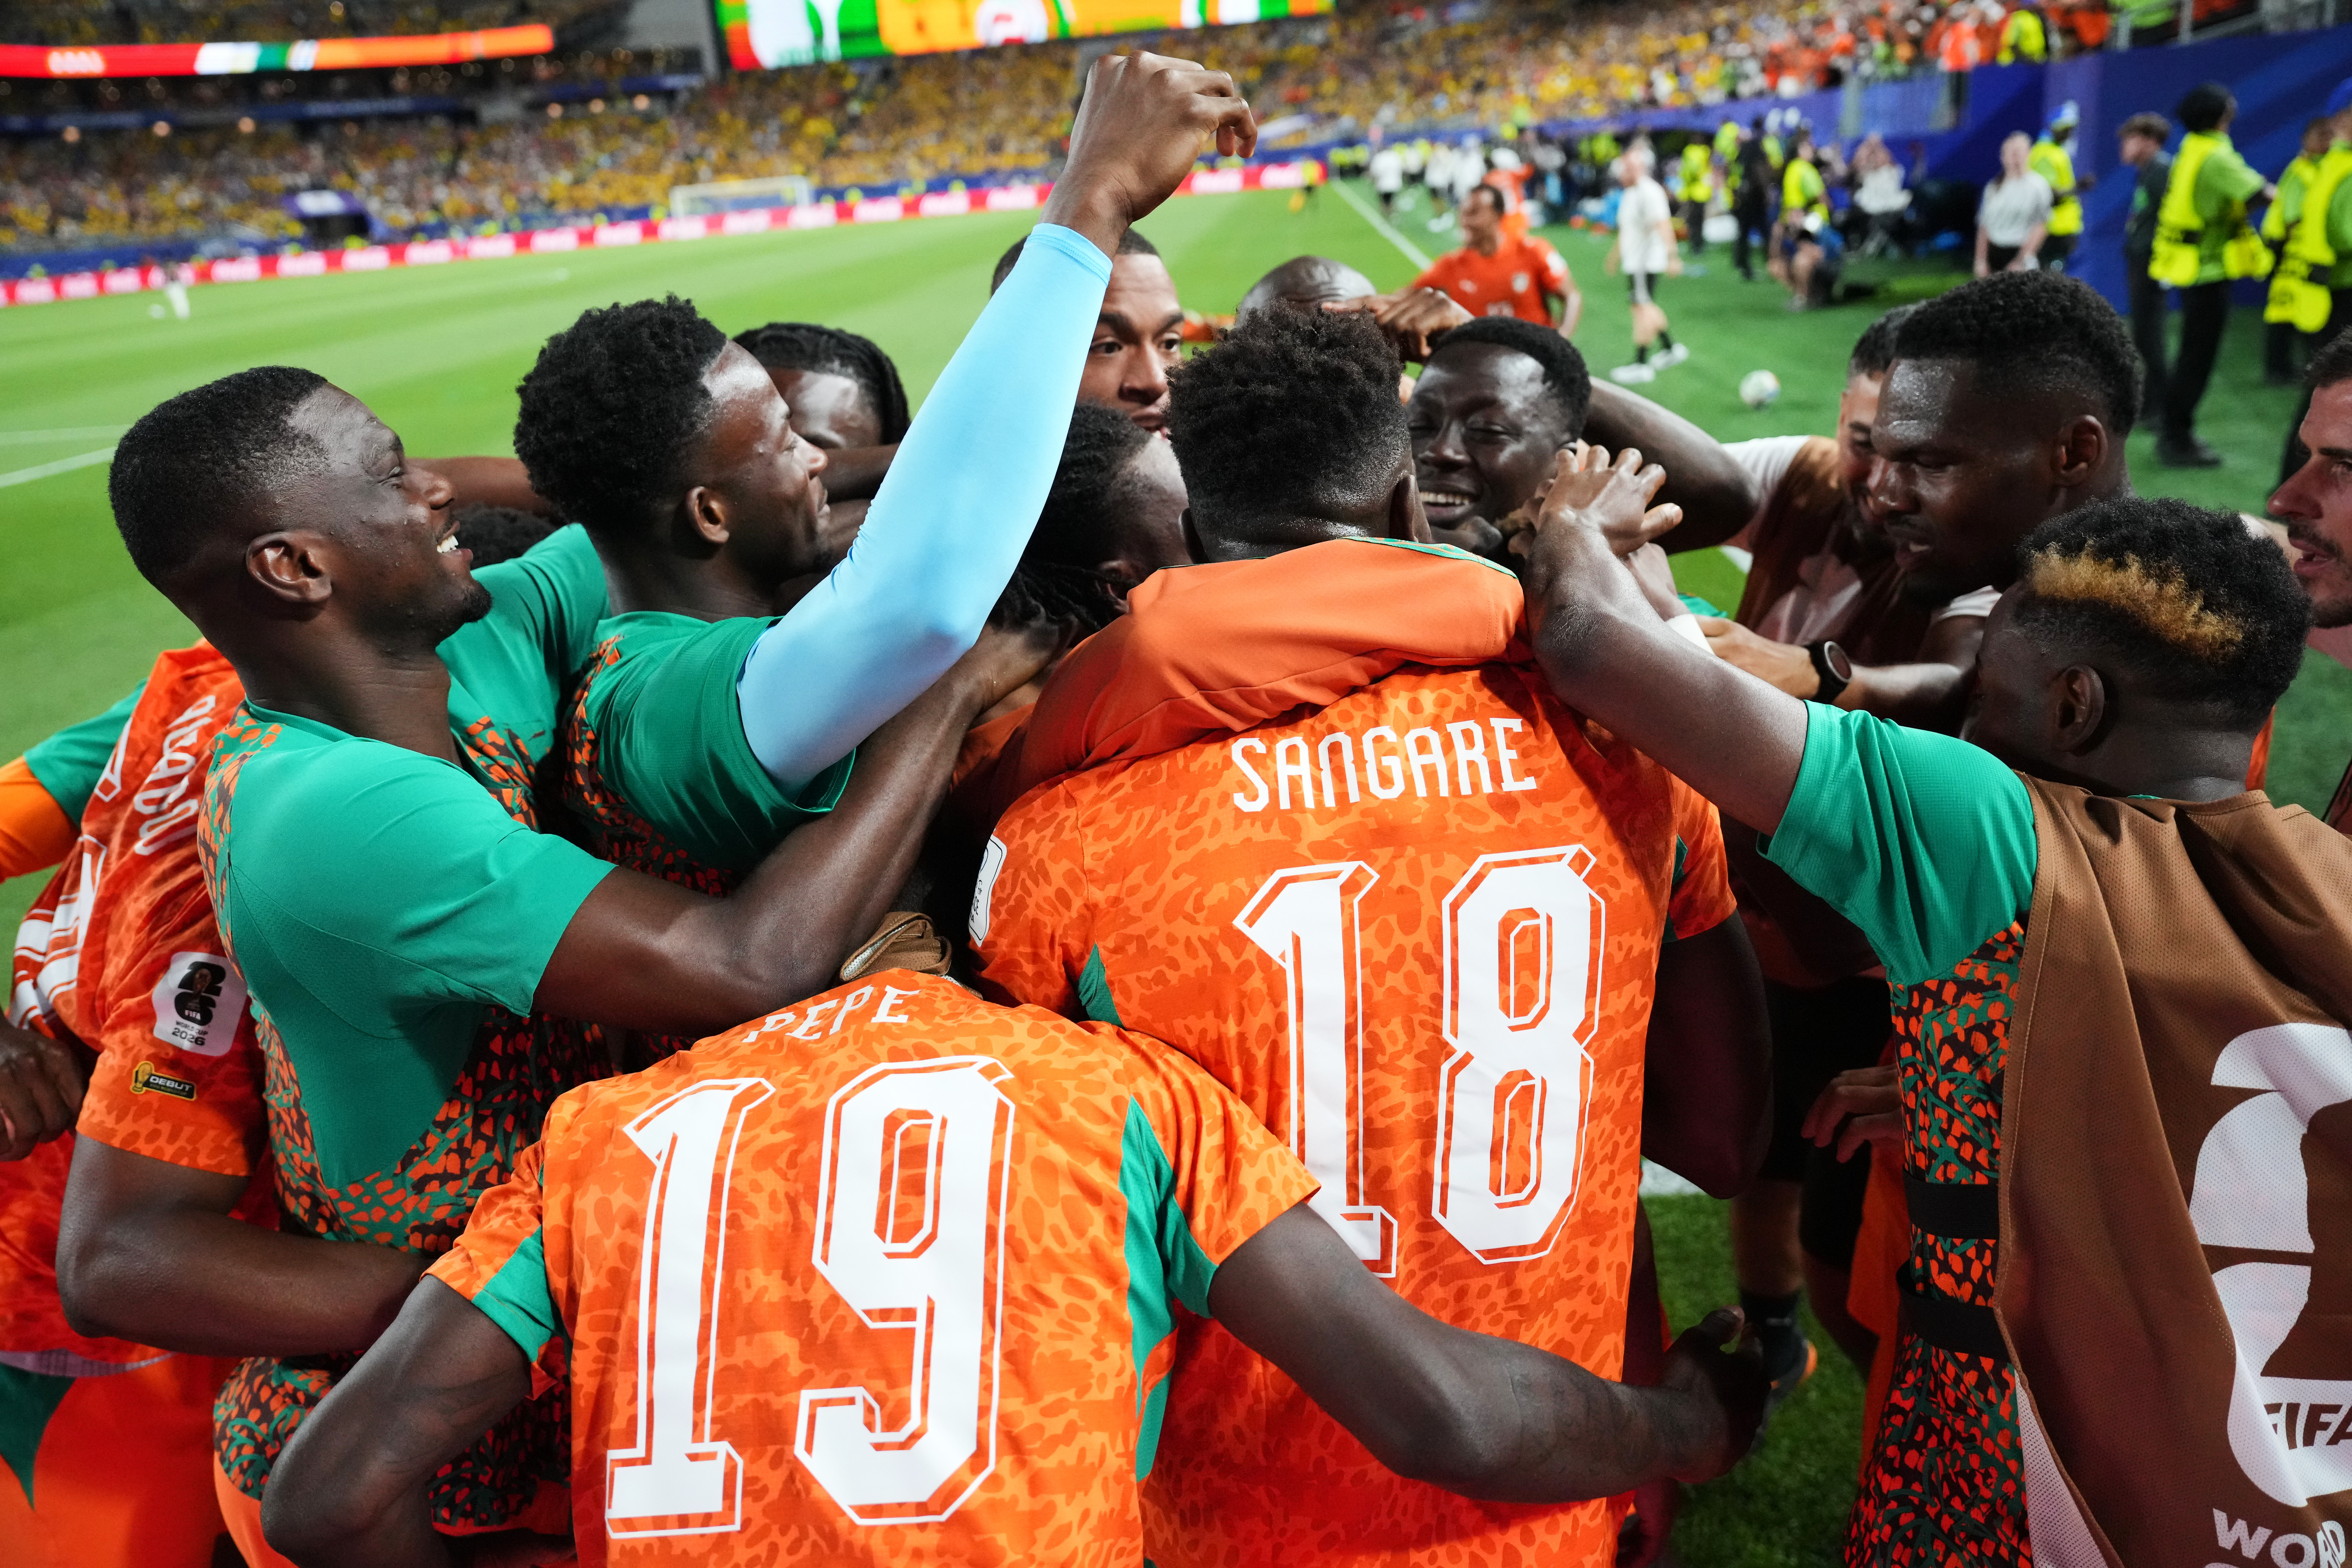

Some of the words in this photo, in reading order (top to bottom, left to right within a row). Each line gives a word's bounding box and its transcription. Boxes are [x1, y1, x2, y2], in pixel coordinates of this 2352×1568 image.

[1231, 717, 1537, 812] SANGARE
[172, 1027, 206, 1046] 2026
[185, 1010, 201, 1020] FIFA
[742, 984, 923, 1043] PEPE
[150, 1075, 193, 1091] DEBUT
[1233, 844, 1605, 1277] 18
[605, 1055, 1014, 1539] 19
